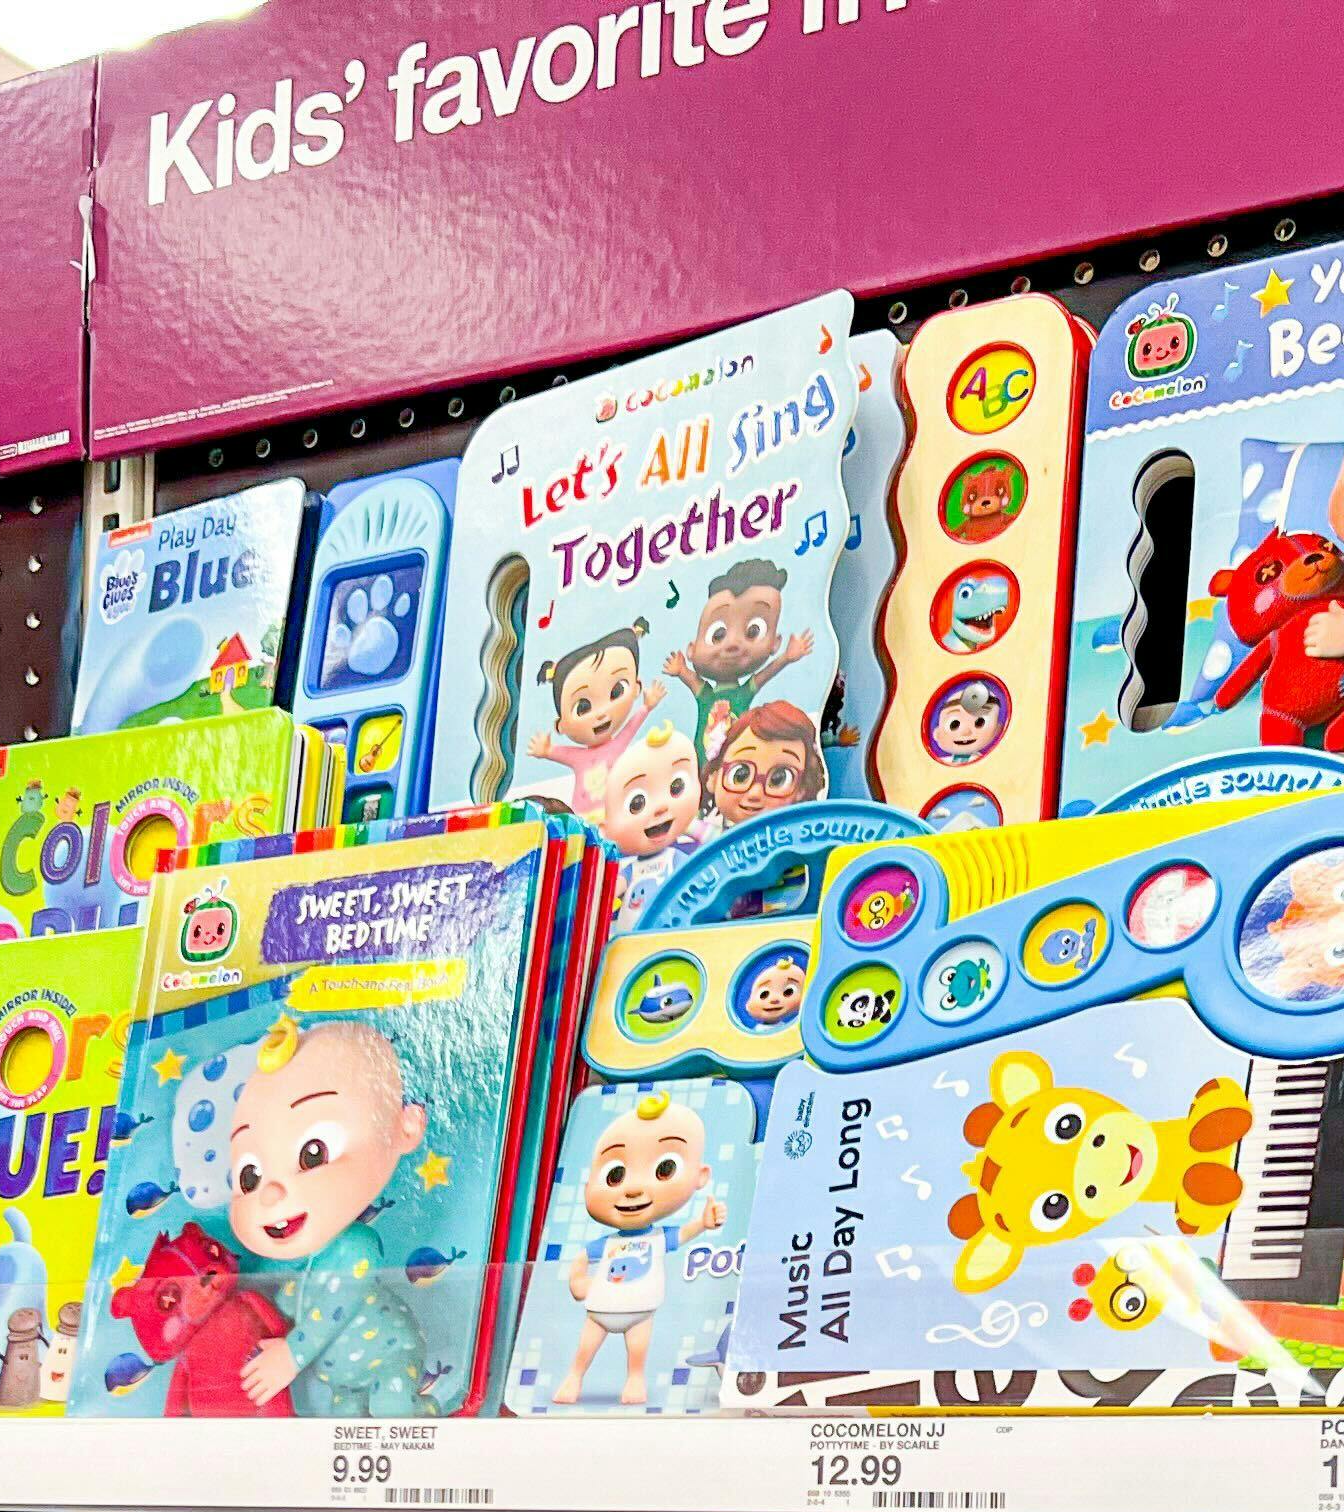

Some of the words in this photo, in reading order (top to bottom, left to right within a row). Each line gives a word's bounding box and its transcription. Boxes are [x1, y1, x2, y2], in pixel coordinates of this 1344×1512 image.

[146, 60, 366, 206] Kids'
[387, 0, 770, 142] favorite
[521, 446, 625, 528] Let's
[639, 415, 712, 490] All
[729, 370, 839, 473] Sing
[158, 527, 196, 552] Play
[551, 480, 800, 597] Together
[324, 914, 434, 955] BEDTIME
[829, 1098, 873, 1192] Long
[823, 1206, 863, 1280] Day
[775, 1231, 814, 1351] Music
[820, 1285, 851, 1345] All
[389, 1426, 438, 1440] SWEET
[810, 1422, 922, 1438] COCOMELON
[810, 1441, 869, 1450] POTTYTIME
[896, 1440, 940, 1450] SCARLE
[332, 1454, 392, 1484] 9.99
[810, 1454, 902, 1486] 12.99
